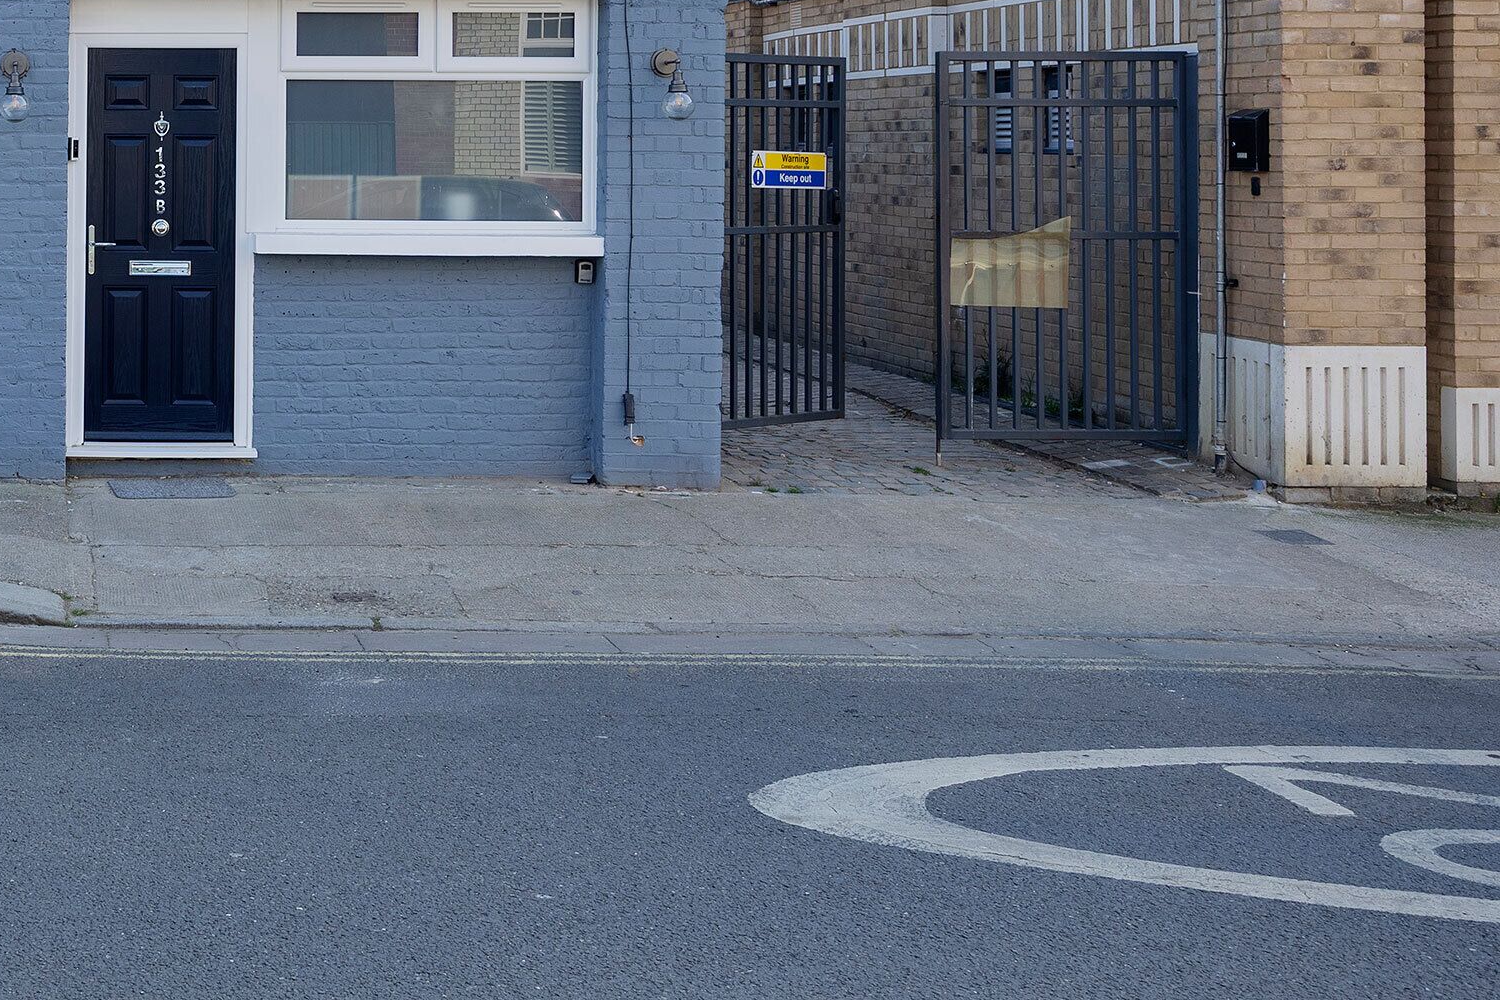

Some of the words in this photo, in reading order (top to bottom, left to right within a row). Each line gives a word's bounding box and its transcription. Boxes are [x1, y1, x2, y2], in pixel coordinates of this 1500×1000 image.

[781, 154, 810, 165] Warning
[779, 173, 799, 184] Keep
[799, 174, 812, 183] out
